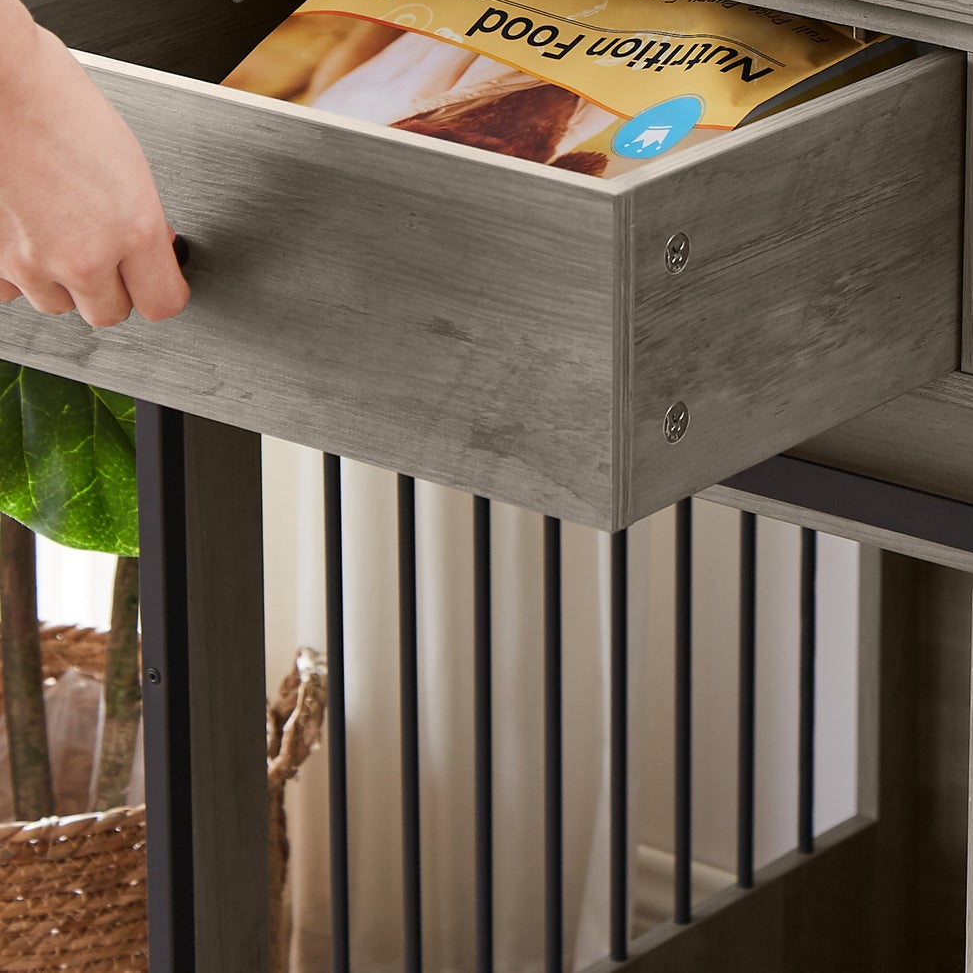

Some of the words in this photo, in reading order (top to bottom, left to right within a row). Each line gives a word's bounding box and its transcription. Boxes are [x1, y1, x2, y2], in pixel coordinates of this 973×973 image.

[465, 6, 575, 61] Food
[586, 30, 774, 83] Nutrition
[792, 24, 831, 44] Full
